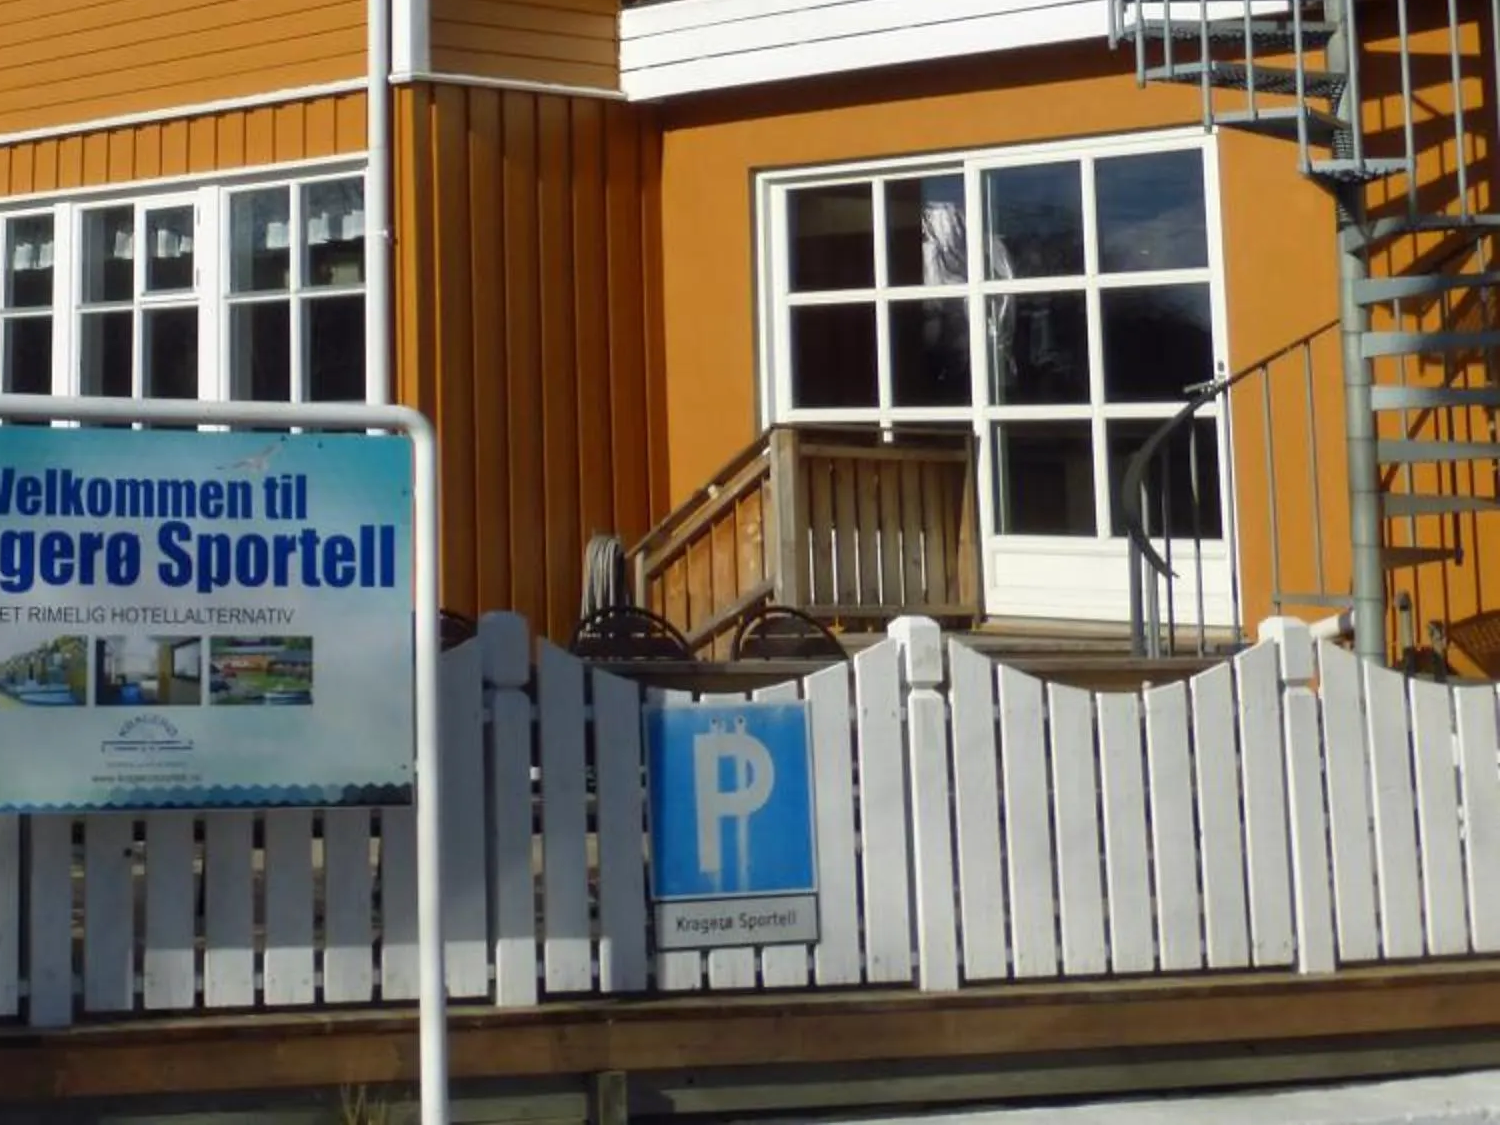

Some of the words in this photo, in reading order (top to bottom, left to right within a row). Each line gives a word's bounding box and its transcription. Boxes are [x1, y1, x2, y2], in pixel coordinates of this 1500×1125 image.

[264, 474, 307, 520] til
[157, 521, 395, 594] Sportell
[0, 606, 23, 623] ET
[28, 606, 104, 624] RIMELIG
[111, 607, 296, 626] HOTELLALTERNATIV
[694, 731, 775, 873] P
